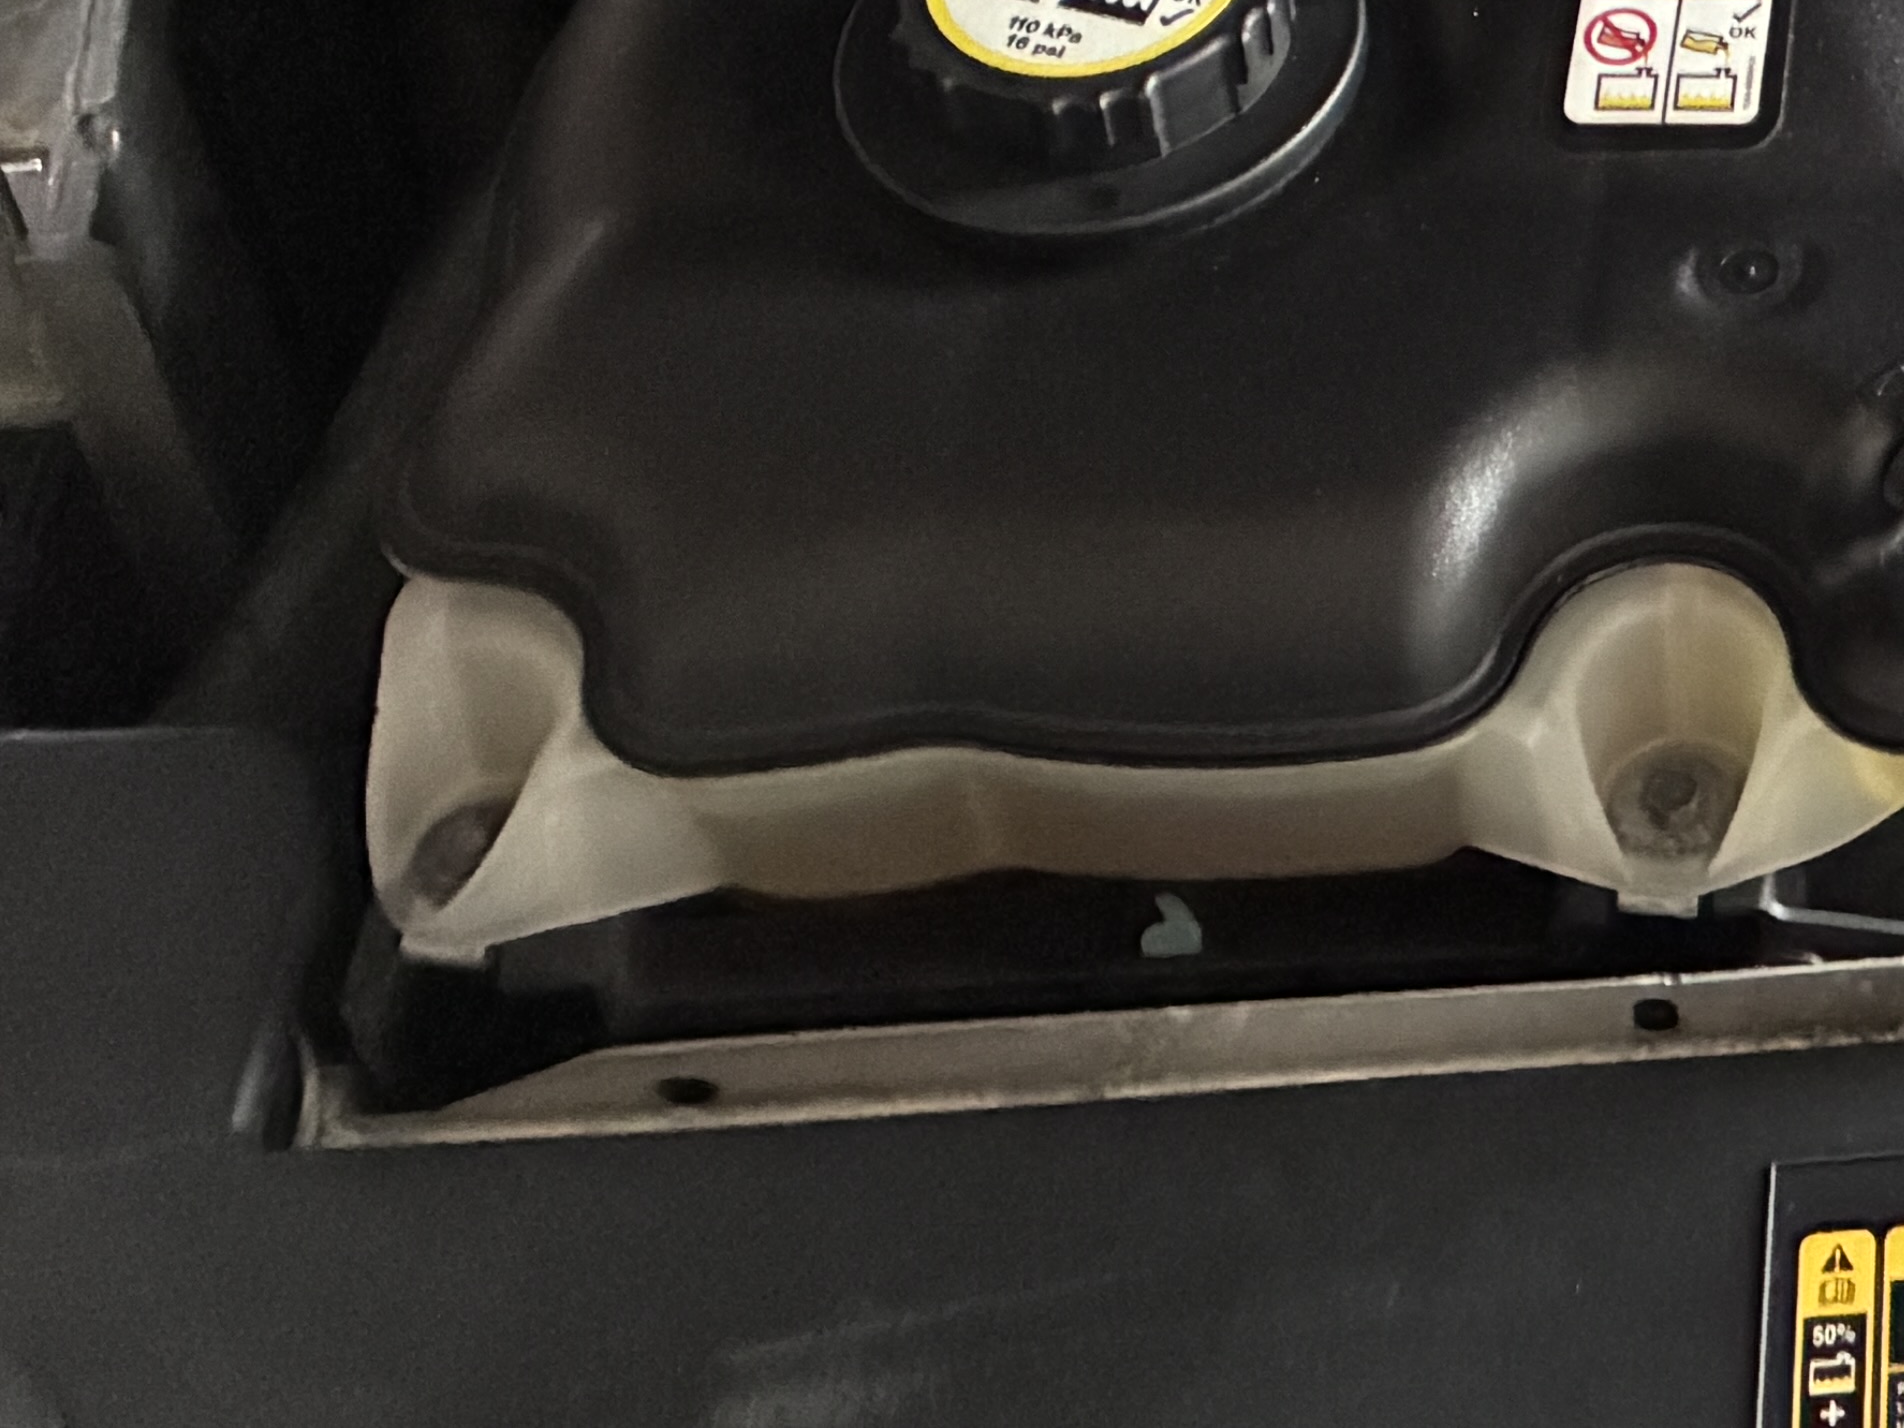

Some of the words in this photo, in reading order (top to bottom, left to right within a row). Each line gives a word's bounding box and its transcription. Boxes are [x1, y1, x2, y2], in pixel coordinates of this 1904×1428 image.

[1008, 15, 1041, 34] 110
[1043, 22, 1083, 44] kPa
[1728, 25, 1758, 40] OK
[1006, 33, 1031, 50] 16
[1811, 1321, 1857, 1347] 50%
